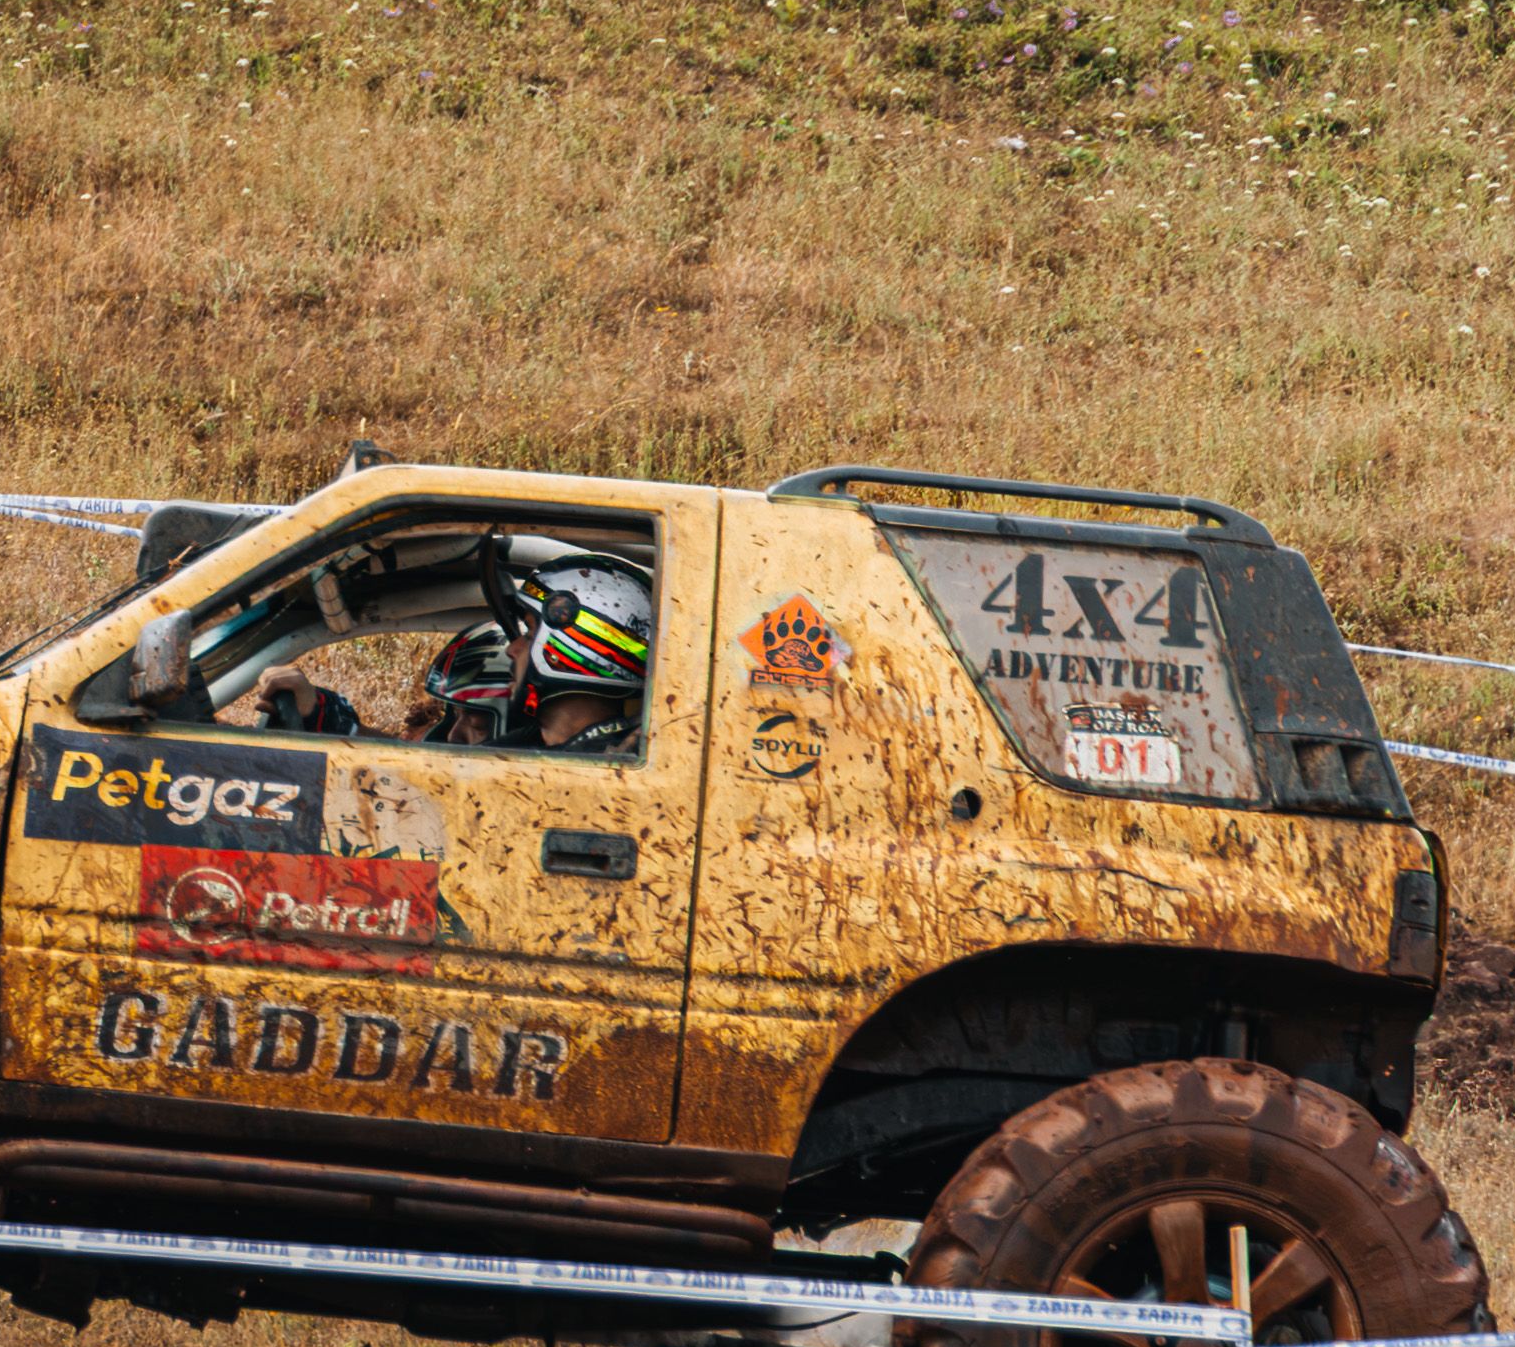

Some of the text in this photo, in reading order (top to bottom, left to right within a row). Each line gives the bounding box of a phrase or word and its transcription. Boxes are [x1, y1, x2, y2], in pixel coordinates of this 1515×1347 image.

[980, 554, 1209, 648] 4x4
[982, 647, 1205, 695] ADVENTURE
[752, 738, 821, 756] SOYLU
[1096, 736, 1149, 775] 01
[52, 751, 300, 826] Petgaz
[95, 990, 571, 1102] GADDAR
[799, 1279, 865, 1301] ZABITA
[910, 1286, 975, 1308] ZABITA
[1027, 1298, 1094, 1317] ZABITA
[1137, 1307, 1204, 1326] ZABITA
